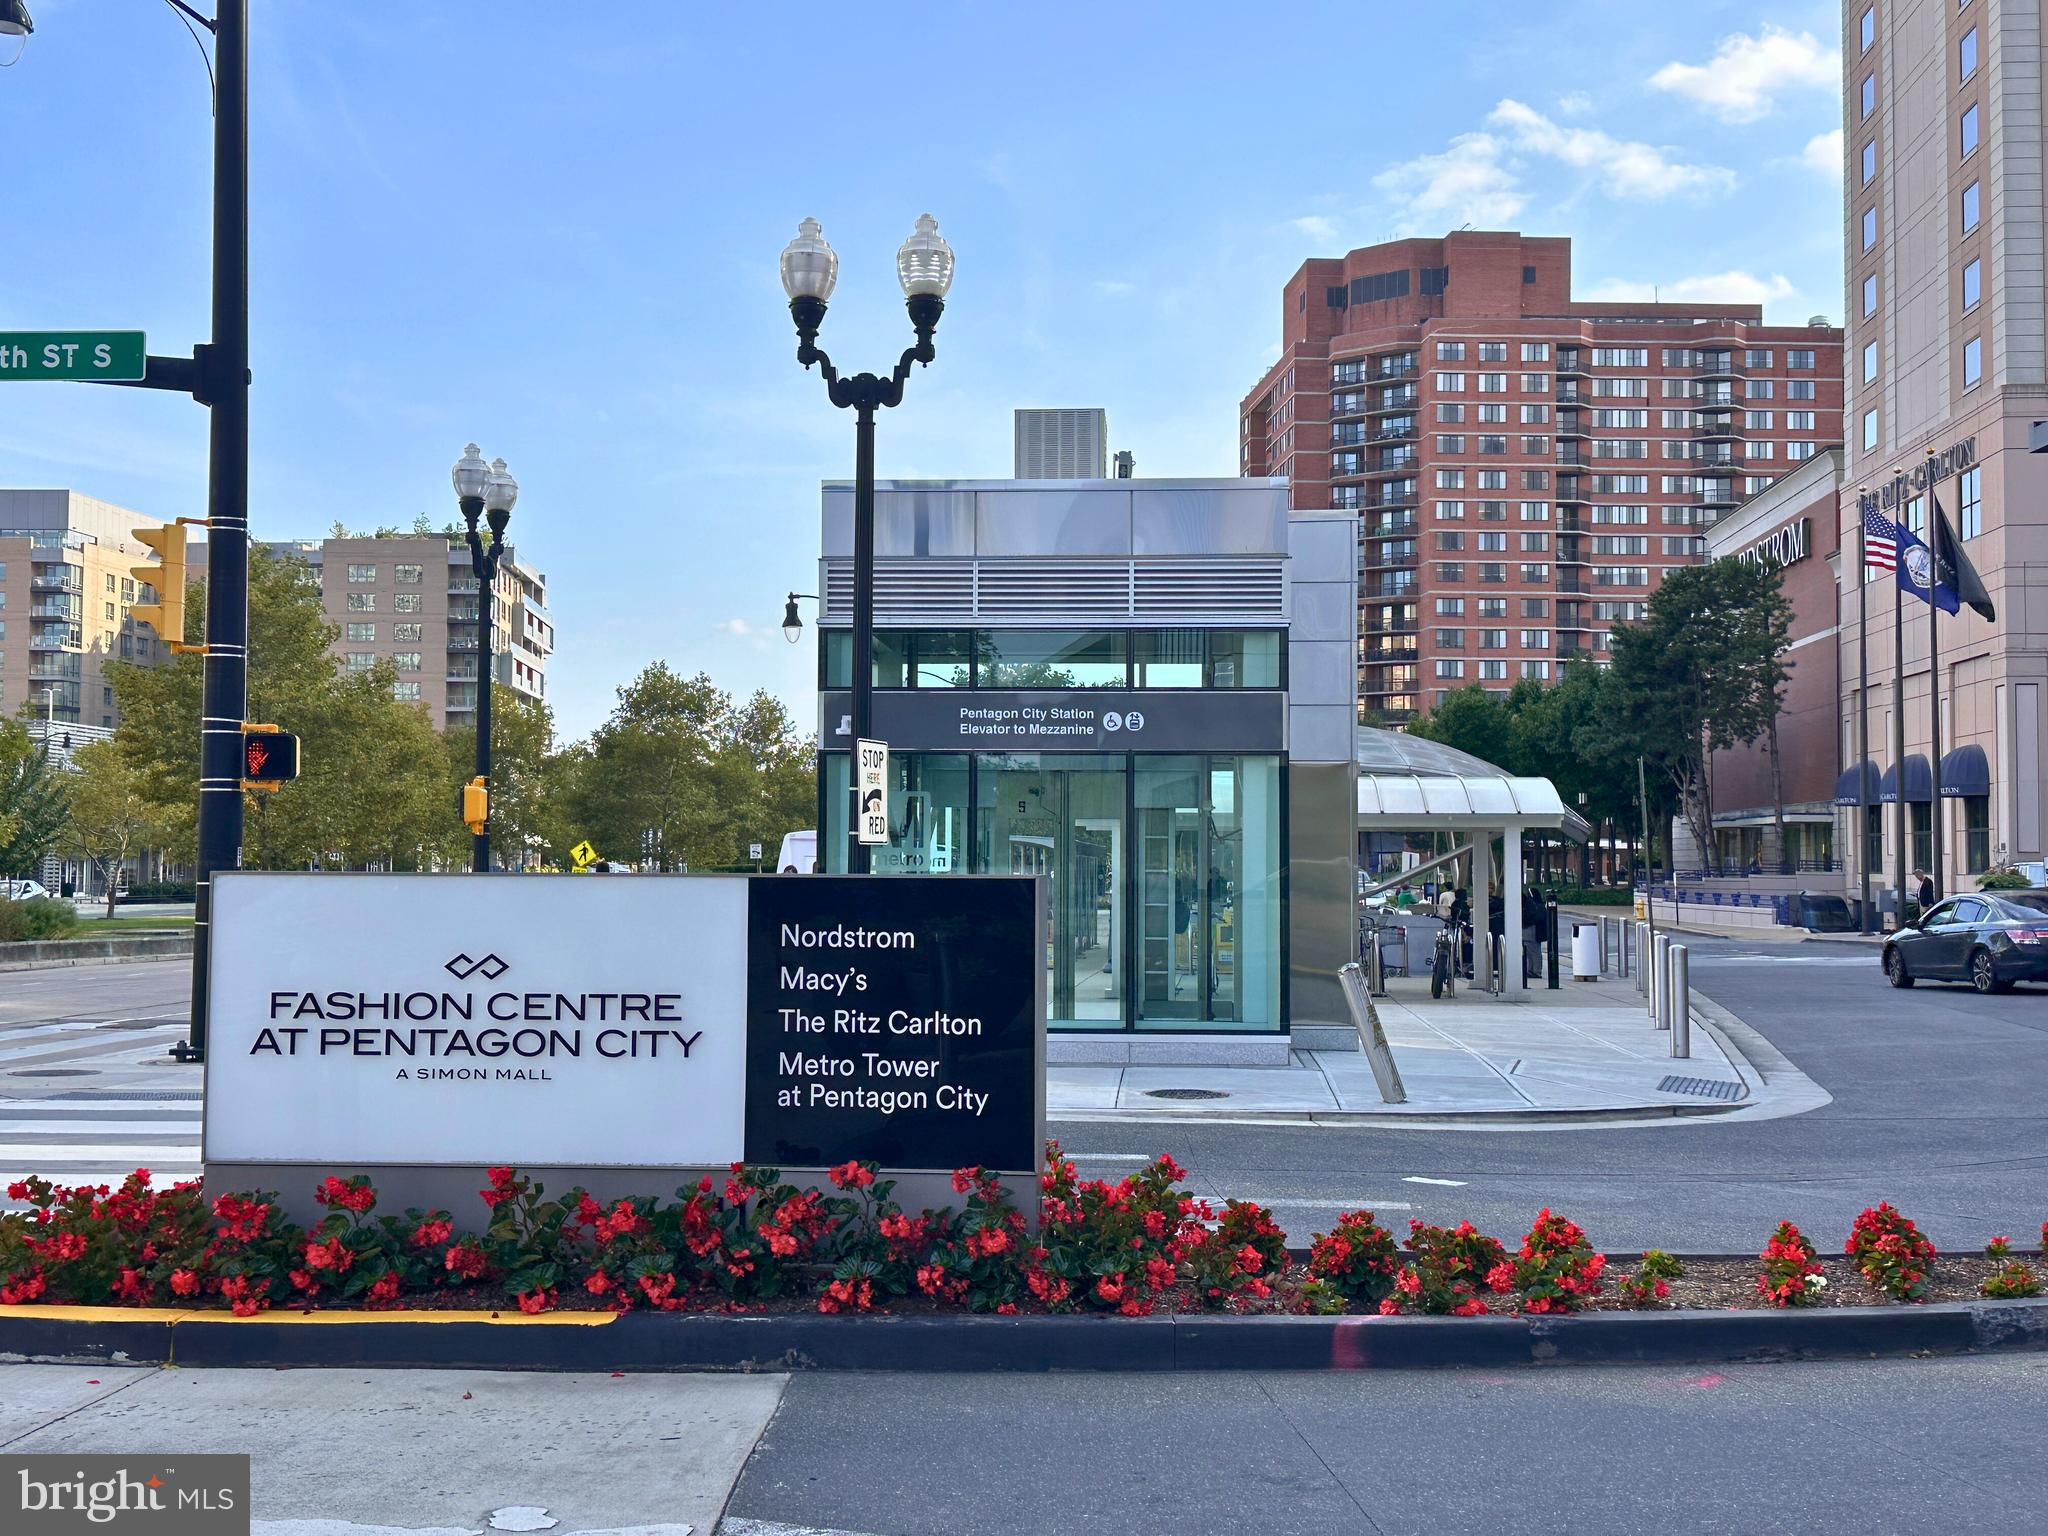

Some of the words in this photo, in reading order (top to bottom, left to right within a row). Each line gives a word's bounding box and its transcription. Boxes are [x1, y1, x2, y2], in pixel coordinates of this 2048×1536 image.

[0, 345, 27, 368] th
[42, 344, 79, 368] ST
[93, 344, 111, 368] S
[1881, 436, 1976, 510] RIZ-CARLTON
[1738, 517, 1804, 581] DSTROM
[960, 708, 1018, 721] Pentagon
[1022, 708, 1047, 721] City
[1050, 708, 1094, 719] Station
[960, 723, 1011, 735] Elevator
[1014, 724, 1026, 735] to
[1029, 724, 1094, 735] Mezzanine
[863, 749, 884, 768] STOP
[869, 816, 885, 835] RED
[781, 923, 915, 949] Nordstrom
[780, 966, 868, 997] Macy’s
[270, 991, 473, 1021] FASHION
[487, 992, 682, 1022] CENTRE
[778, 1008, 826, 1033] The
[834, 1009, 881, 1034] Ritz
[888, 1010, 982, 1035] Carlton
[249, 1028, 309, 1056] AT
[319, 1028, 581, 1058] PENTAGON
[595, 1029, 703, 1058] CITY
[395, 1068, 409, 1080] A
[417, 1068, 487, 1080] SIMON
[495, 1068, 552, 1081] MALL
[779, 1051, 855, 1077] Metro
[861, 1053, 940, 1078] Tower
[777, 1085, 801, 1107] at
[810, 1083, 927, 1115] Pentagon
[936, 1085, 989, 1116] City
